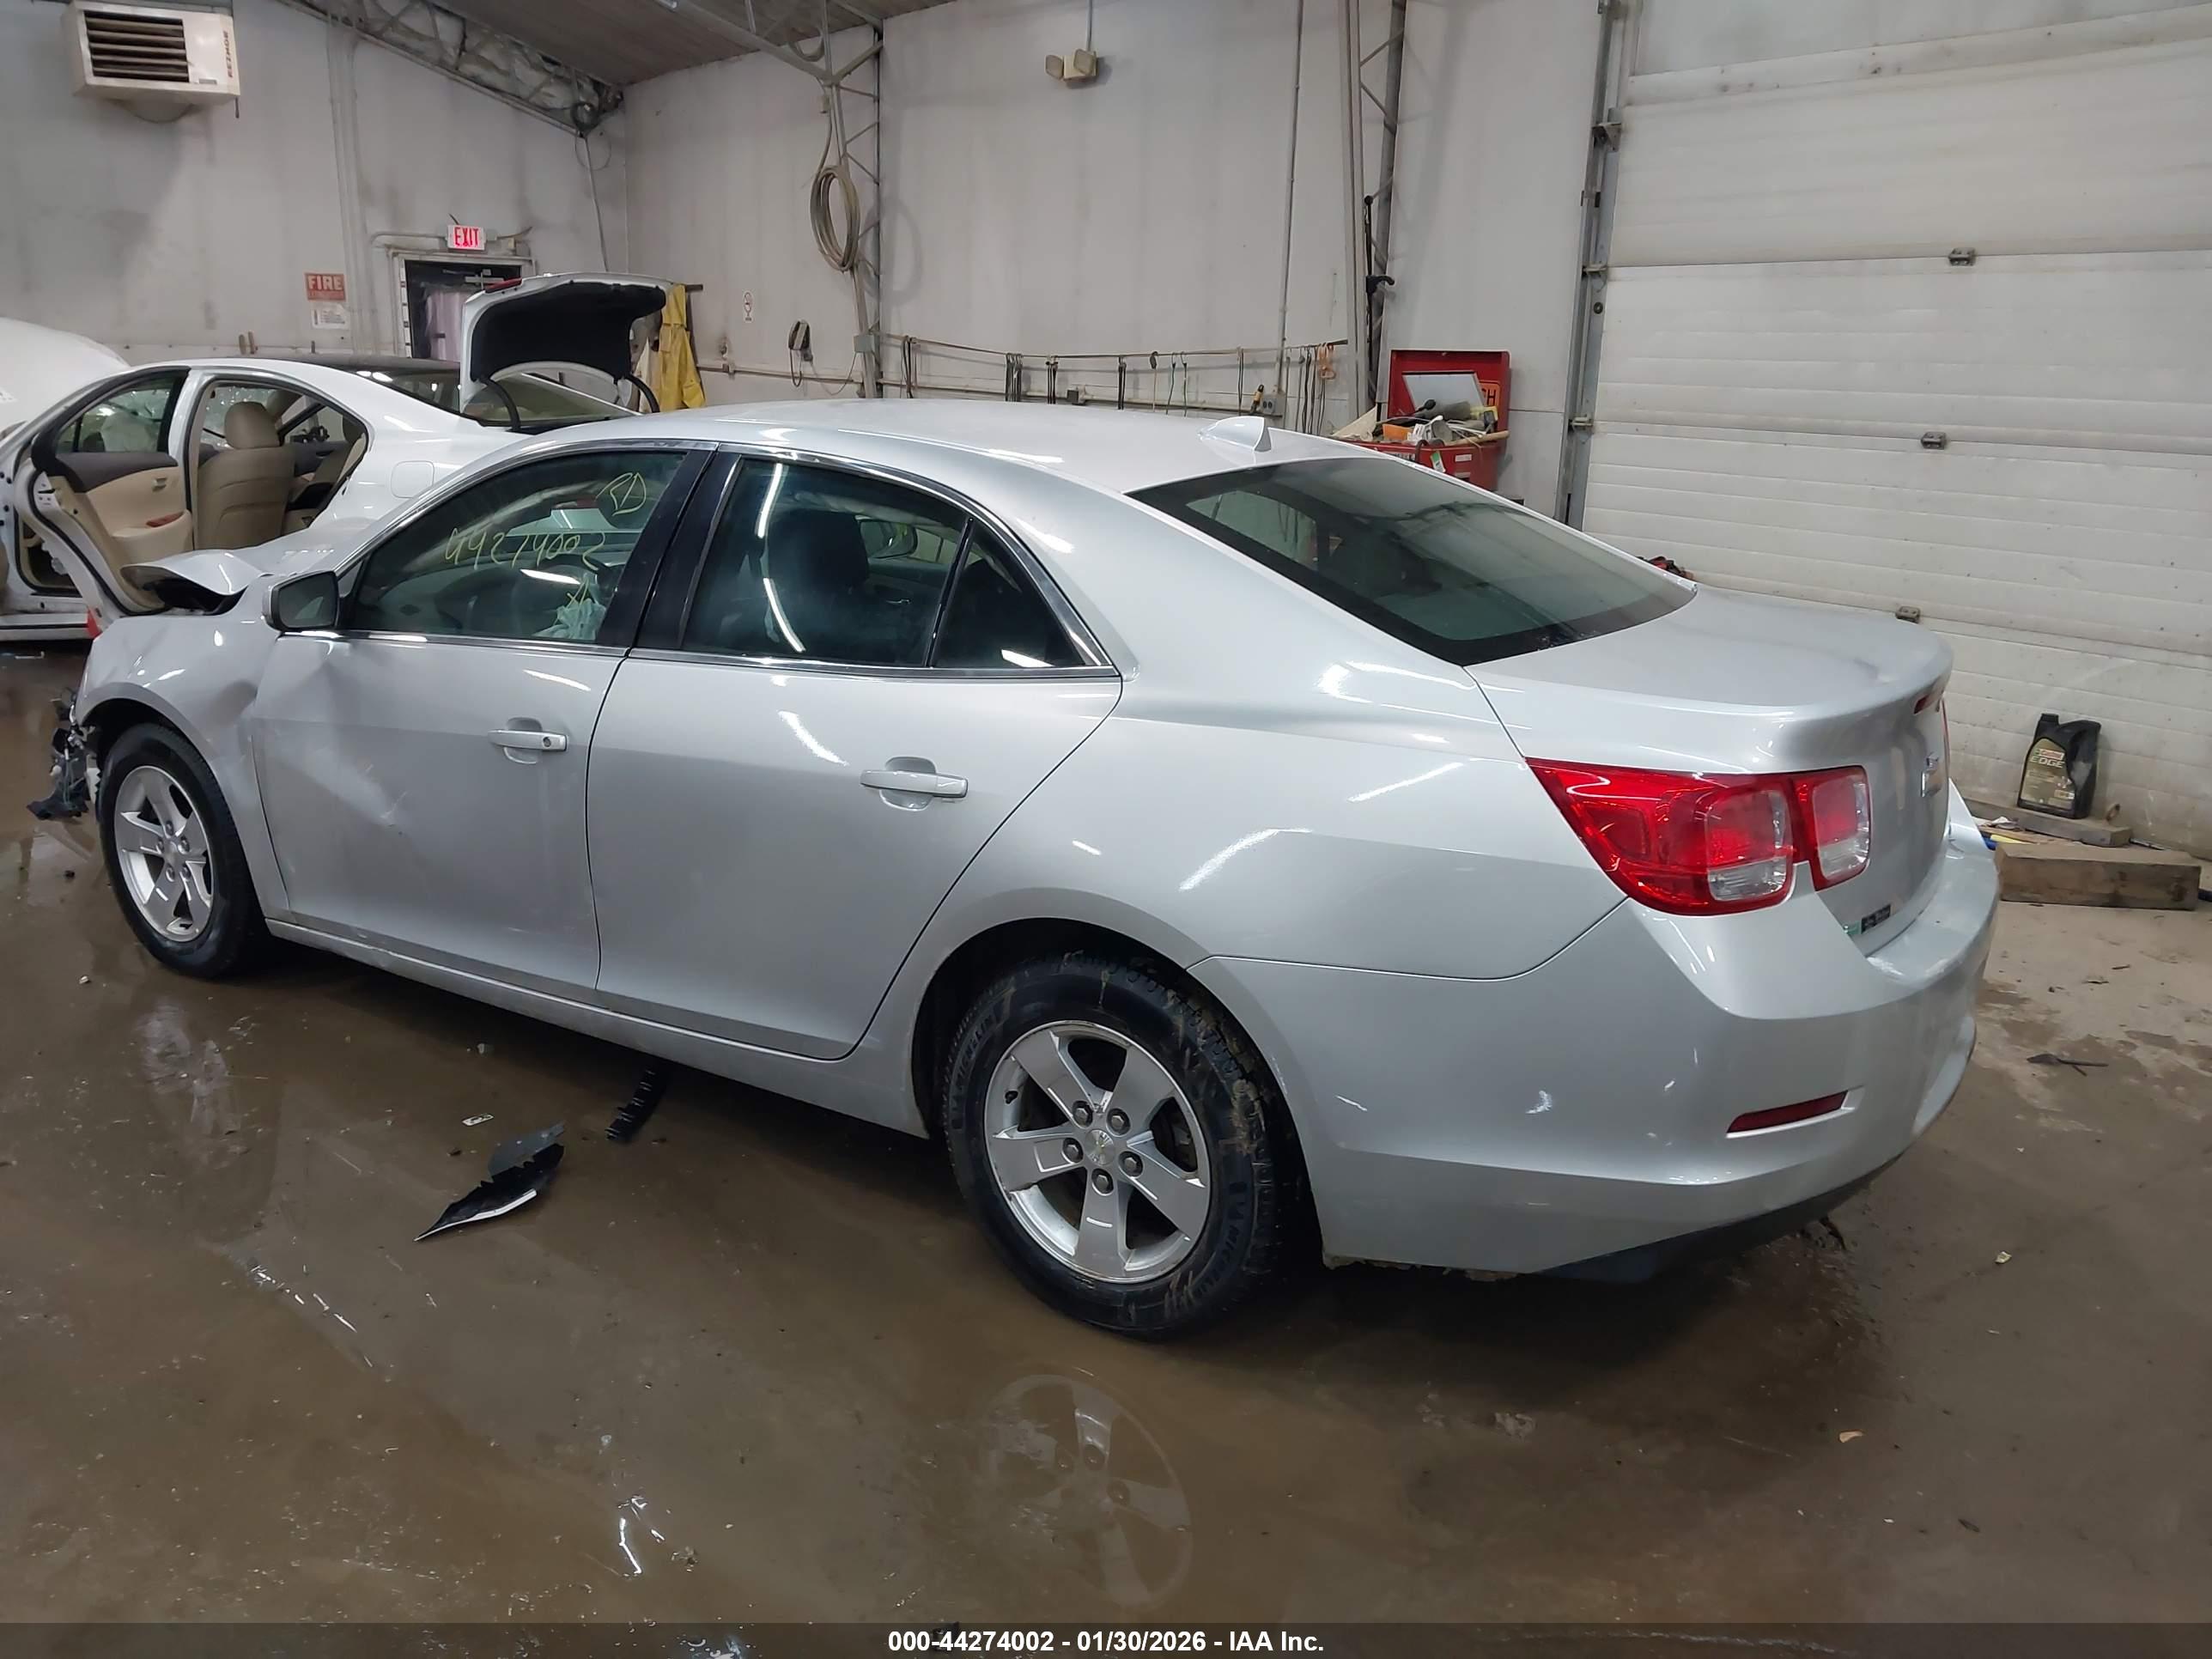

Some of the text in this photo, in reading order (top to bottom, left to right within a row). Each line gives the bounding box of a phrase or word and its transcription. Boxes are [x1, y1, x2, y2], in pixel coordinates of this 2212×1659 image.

[455, 227, 479, 247] EXIT
[308, 275, 343, 290] FIRE
[445, 527, 606, 571] 44274002
[2029, 756, 2066, 769] EDGE
